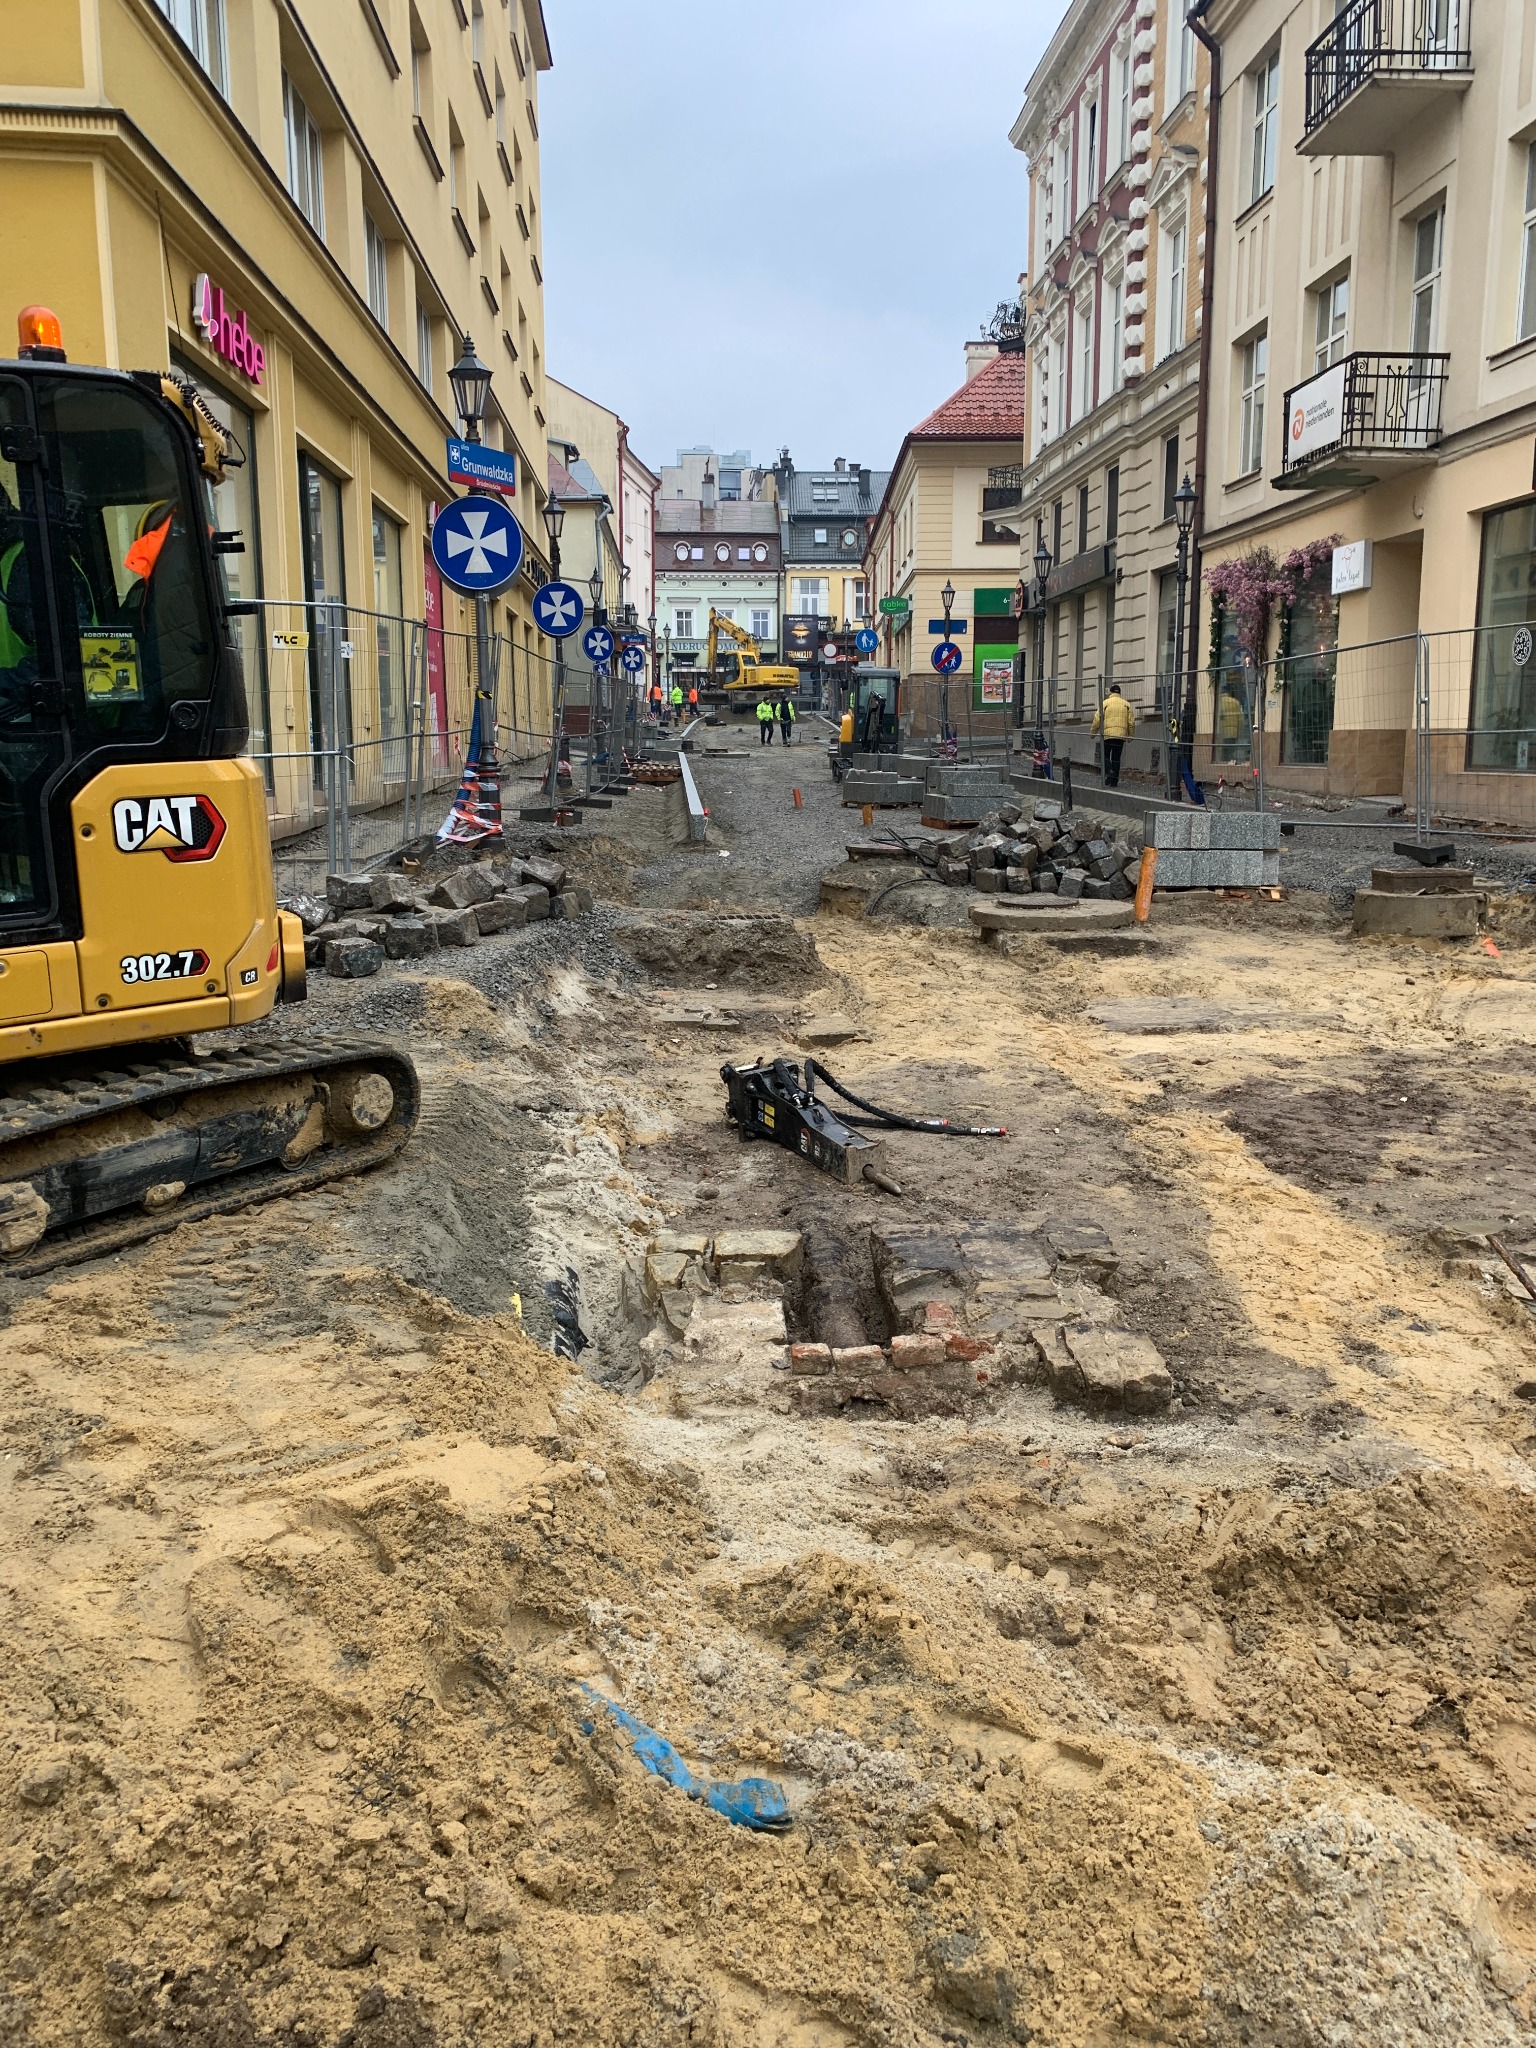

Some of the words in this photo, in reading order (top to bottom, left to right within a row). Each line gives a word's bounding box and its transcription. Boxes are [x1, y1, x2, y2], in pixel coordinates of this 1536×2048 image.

[213, 287, 266, 385] hebe
[1306, 400, 1328, 417] nationale
[1306, 408, 1335, 428] nederlanden
[461, 456, 514, 483] Grunwaldzka
[882, 600, 907, 608] żabka
[274, 635, 298, 644] TLC
[113, 796, 198, 851] CAT
[121, 950, 194, 984] 302.7
[244, 971, 256, 983] CR
[800, 1132, 808, 1153] CAT
